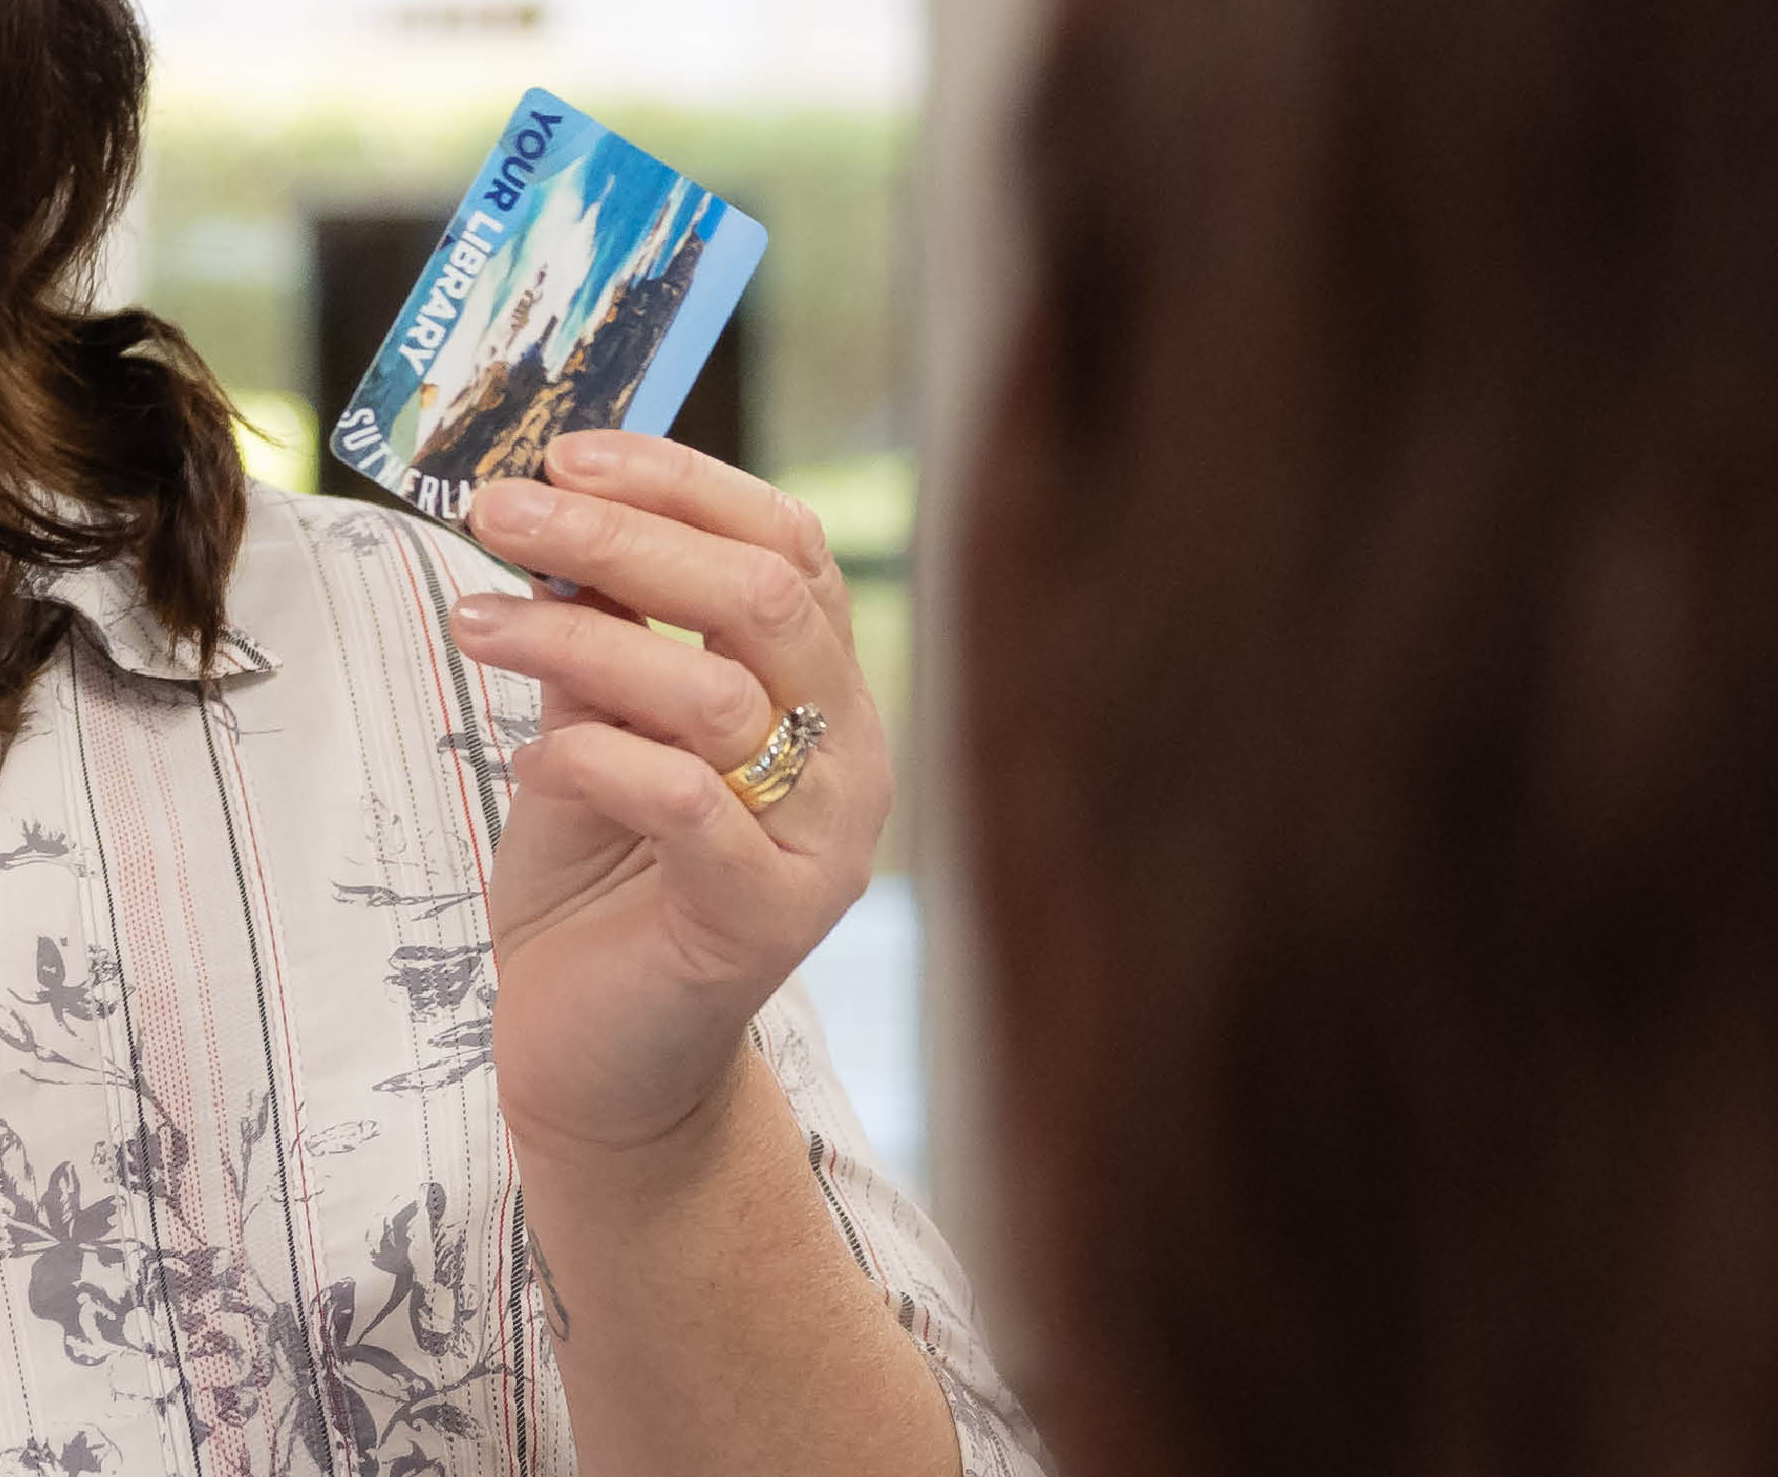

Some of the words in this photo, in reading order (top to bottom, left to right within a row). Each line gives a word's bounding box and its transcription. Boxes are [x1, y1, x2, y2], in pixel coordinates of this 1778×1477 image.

[484, 110, 563, 212] YOUR
[398, 210, 504, 377] LIBRARY
[337, 407, 475, 521] SUTHERLA
